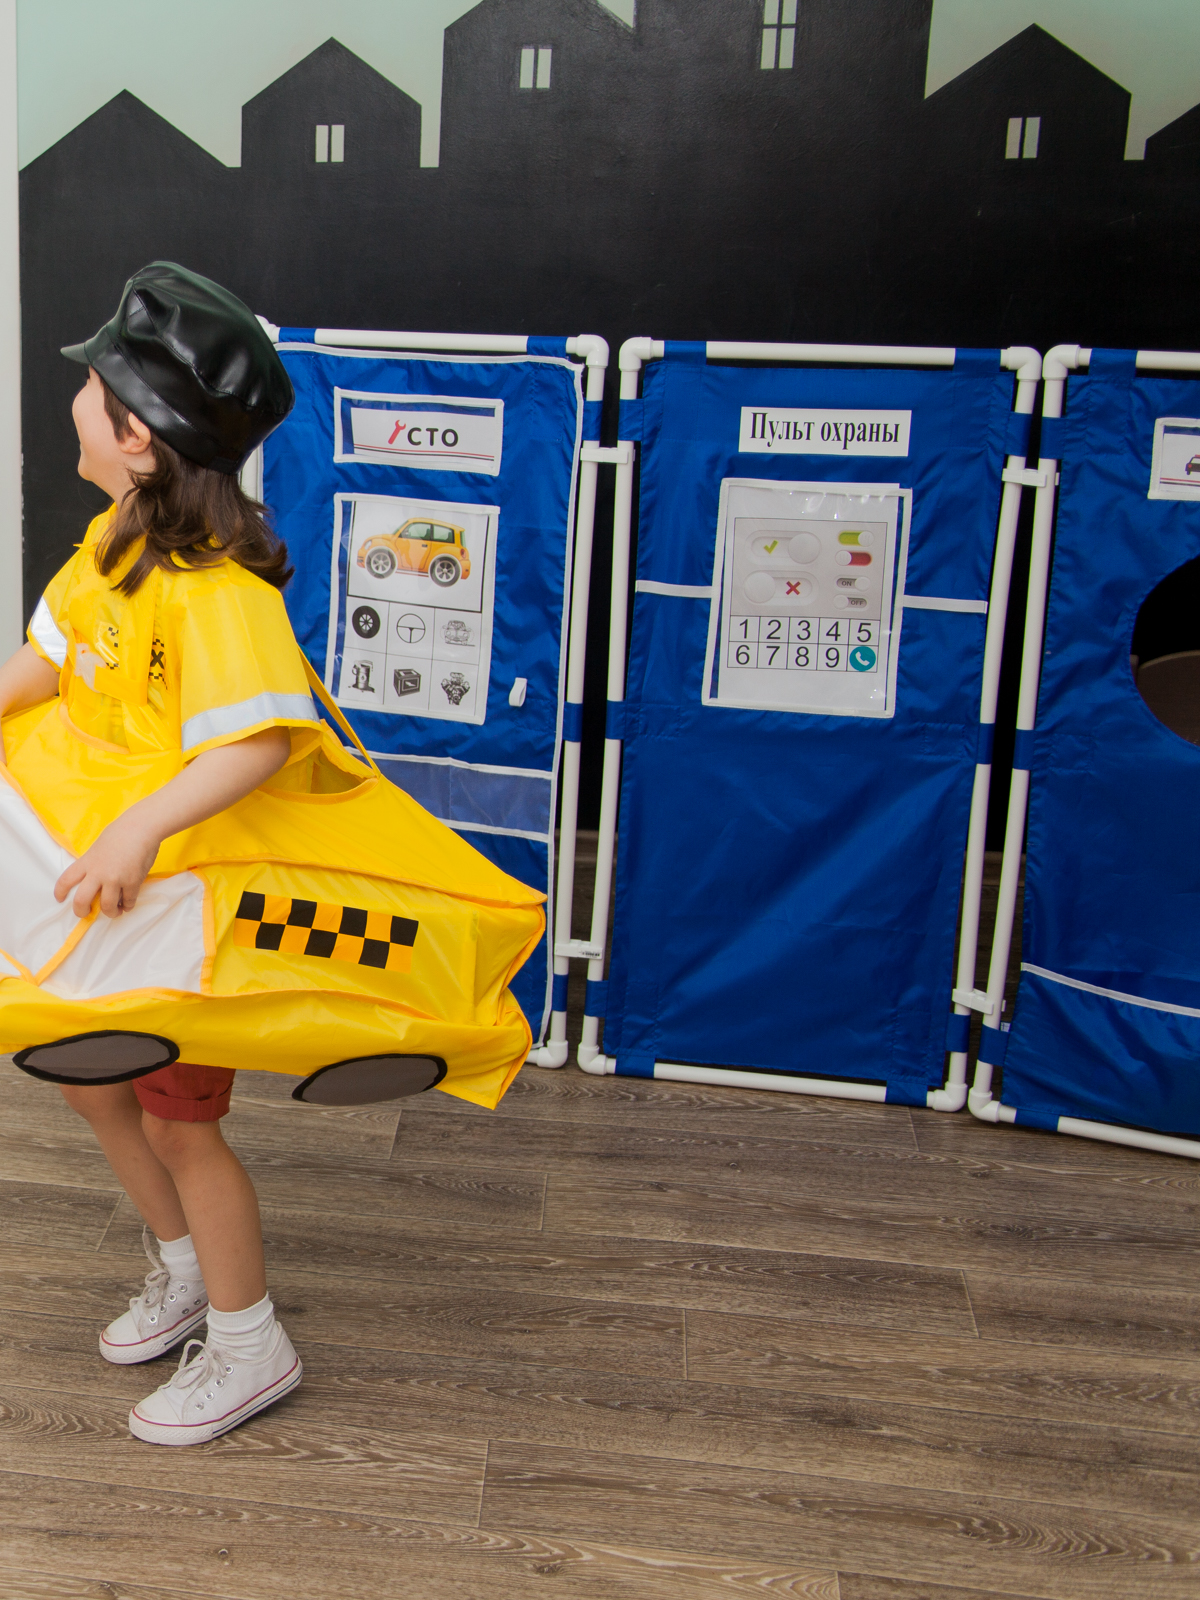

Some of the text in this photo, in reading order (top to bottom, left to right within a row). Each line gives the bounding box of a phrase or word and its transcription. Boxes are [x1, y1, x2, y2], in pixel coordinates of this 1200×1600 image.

[407, 426, 459, 447] СТО
[750, 412, 900, 450] Пульт охраны
[739, 618, 872, 643] 1 2 3 4 5
[735, 644, 840, 668] 6 7 8 9
